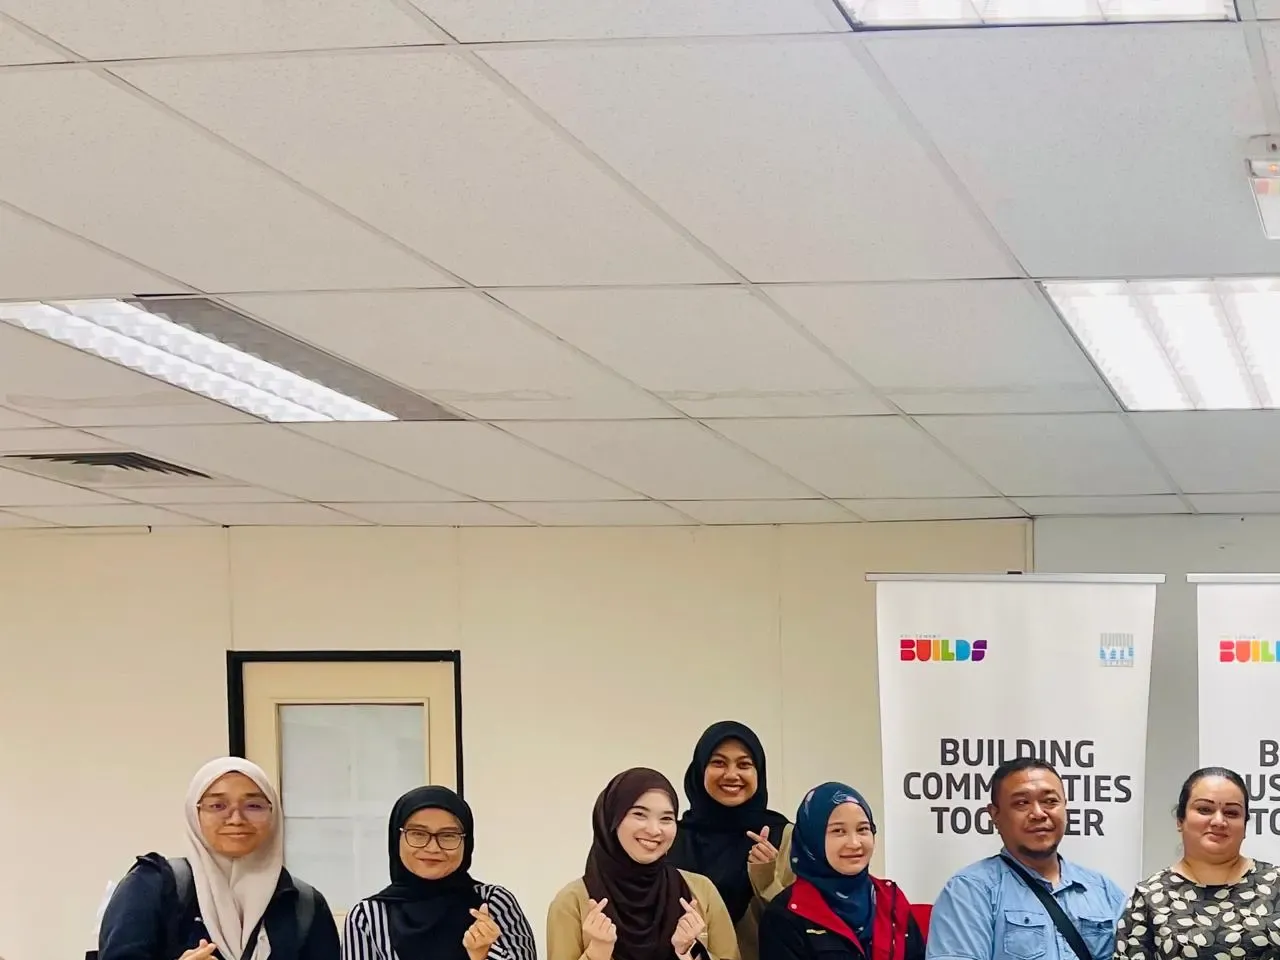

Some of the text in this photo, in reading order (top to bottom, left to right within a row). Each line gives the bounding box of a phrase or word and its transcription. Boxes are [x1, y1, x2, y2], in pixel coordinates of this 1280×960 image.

[900, 639, 987, 661] BUILDS
[903, 772, 1132, 803] COMMTIES
[931, 806, 1105, 836] TOGER
